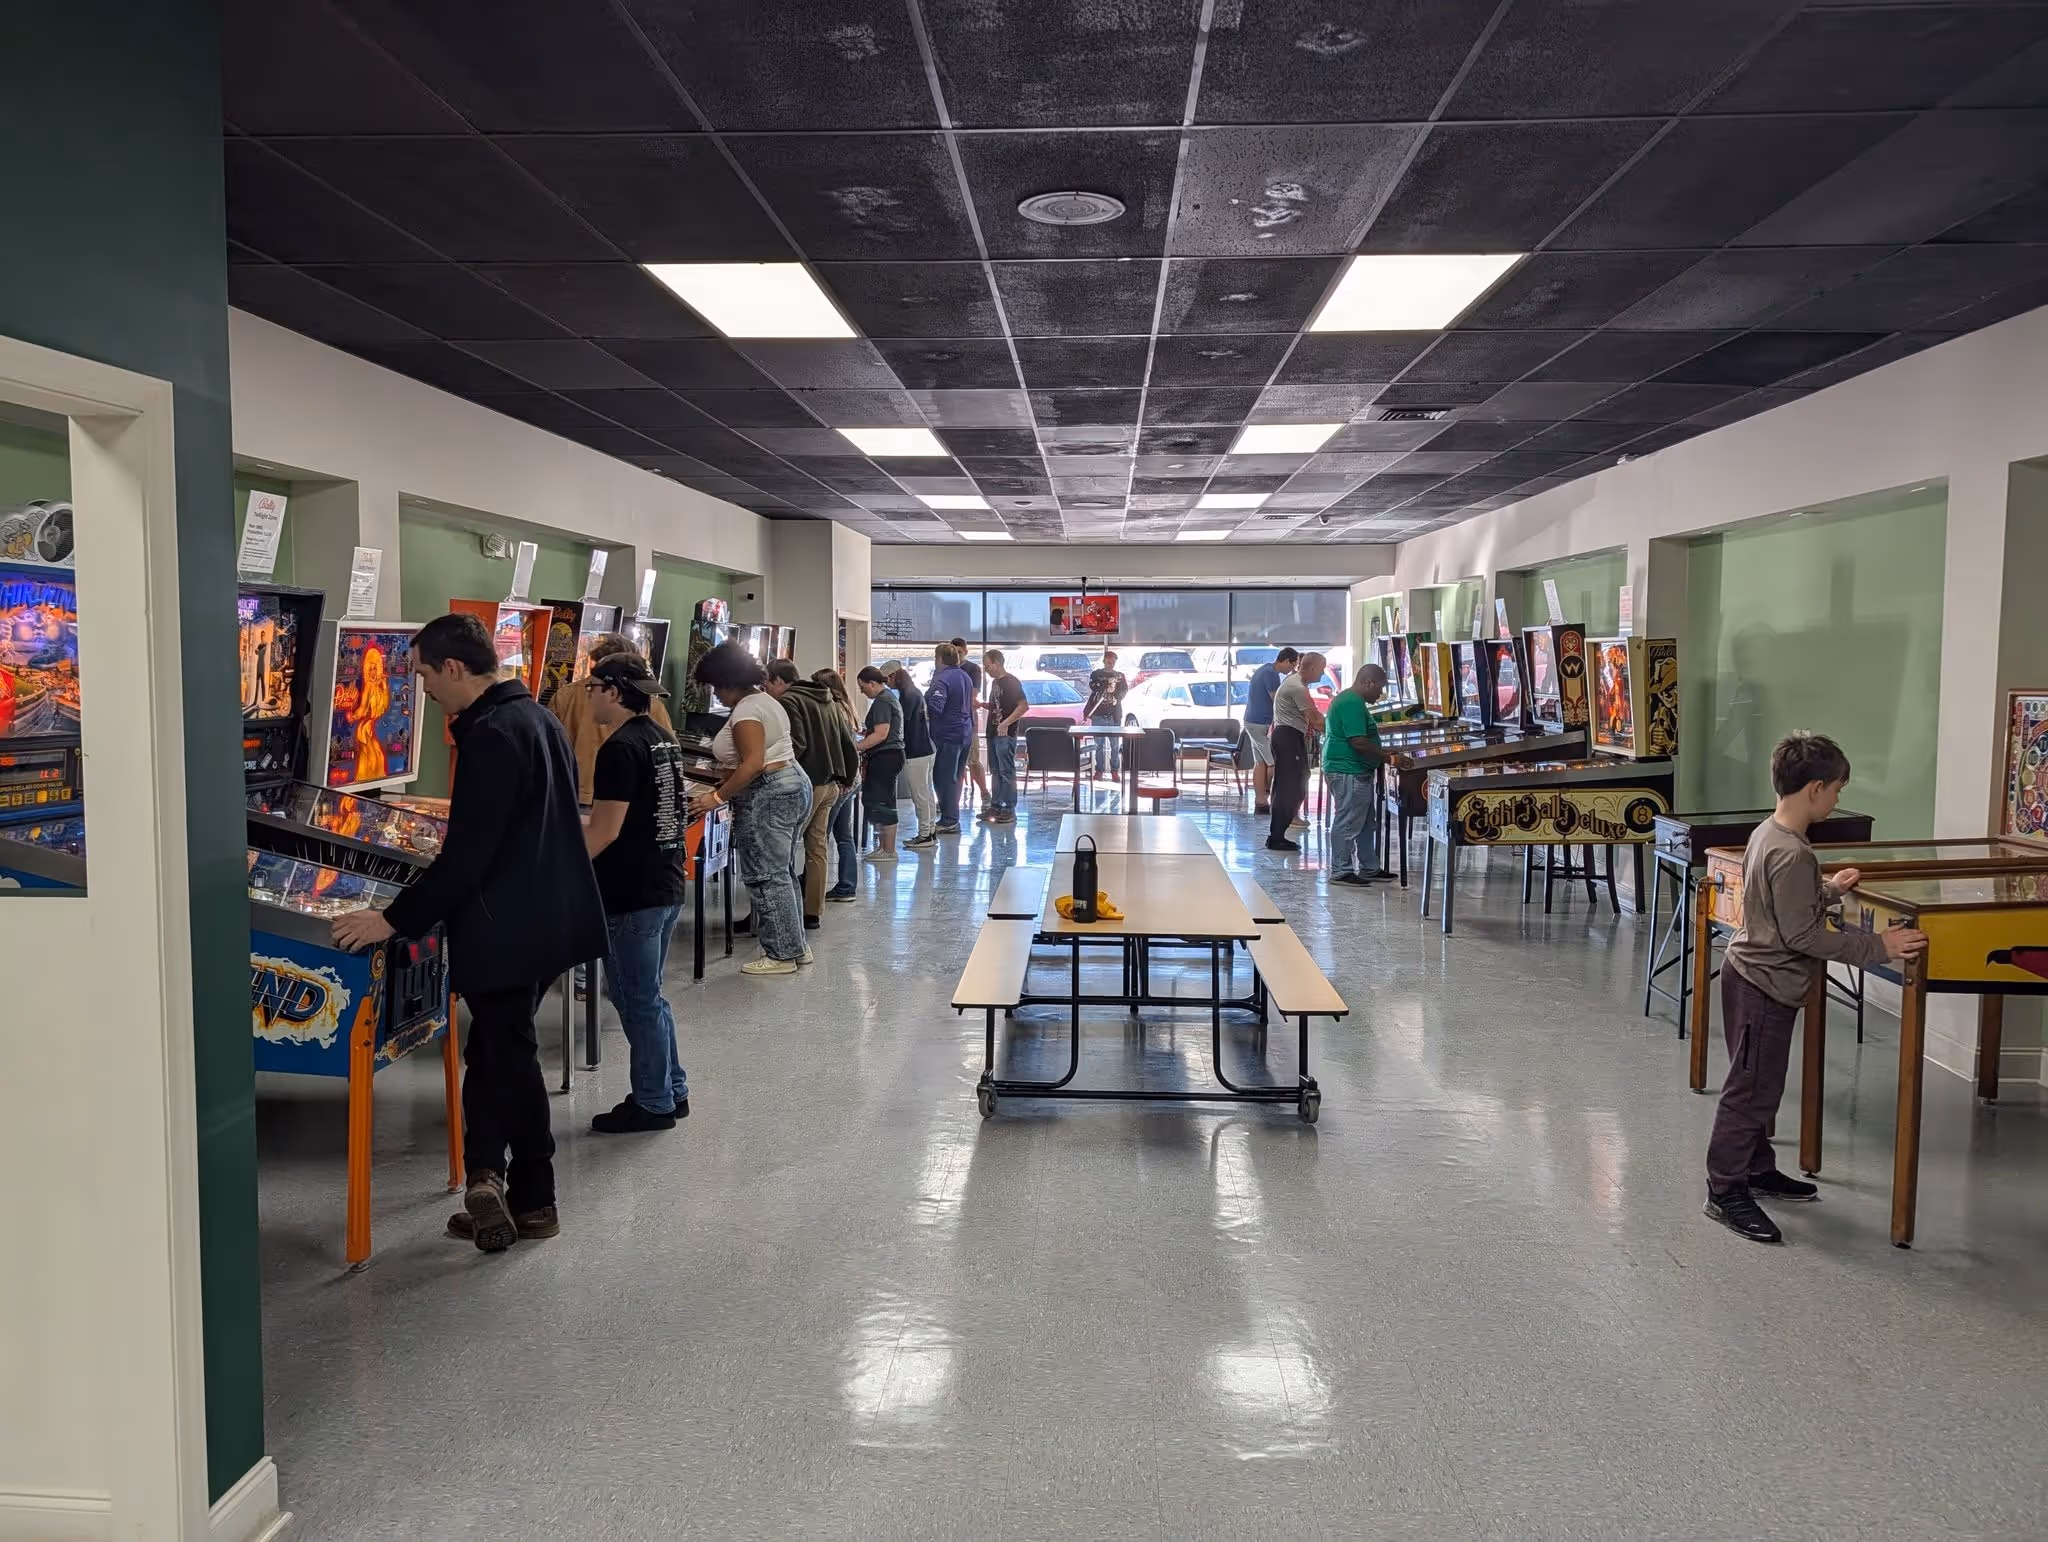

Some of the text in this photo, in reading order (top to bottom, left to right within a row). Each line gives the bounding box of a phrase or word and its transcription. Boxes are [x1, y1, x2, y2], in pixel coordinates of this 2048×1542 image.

[0, 582, 76, 613] HIRLWIN
[553, 606, 576, 622] Bally
[1464, 792, 1628, 841] Eight Ball Deluxe
[1636, 805, 1650, 826] 8
